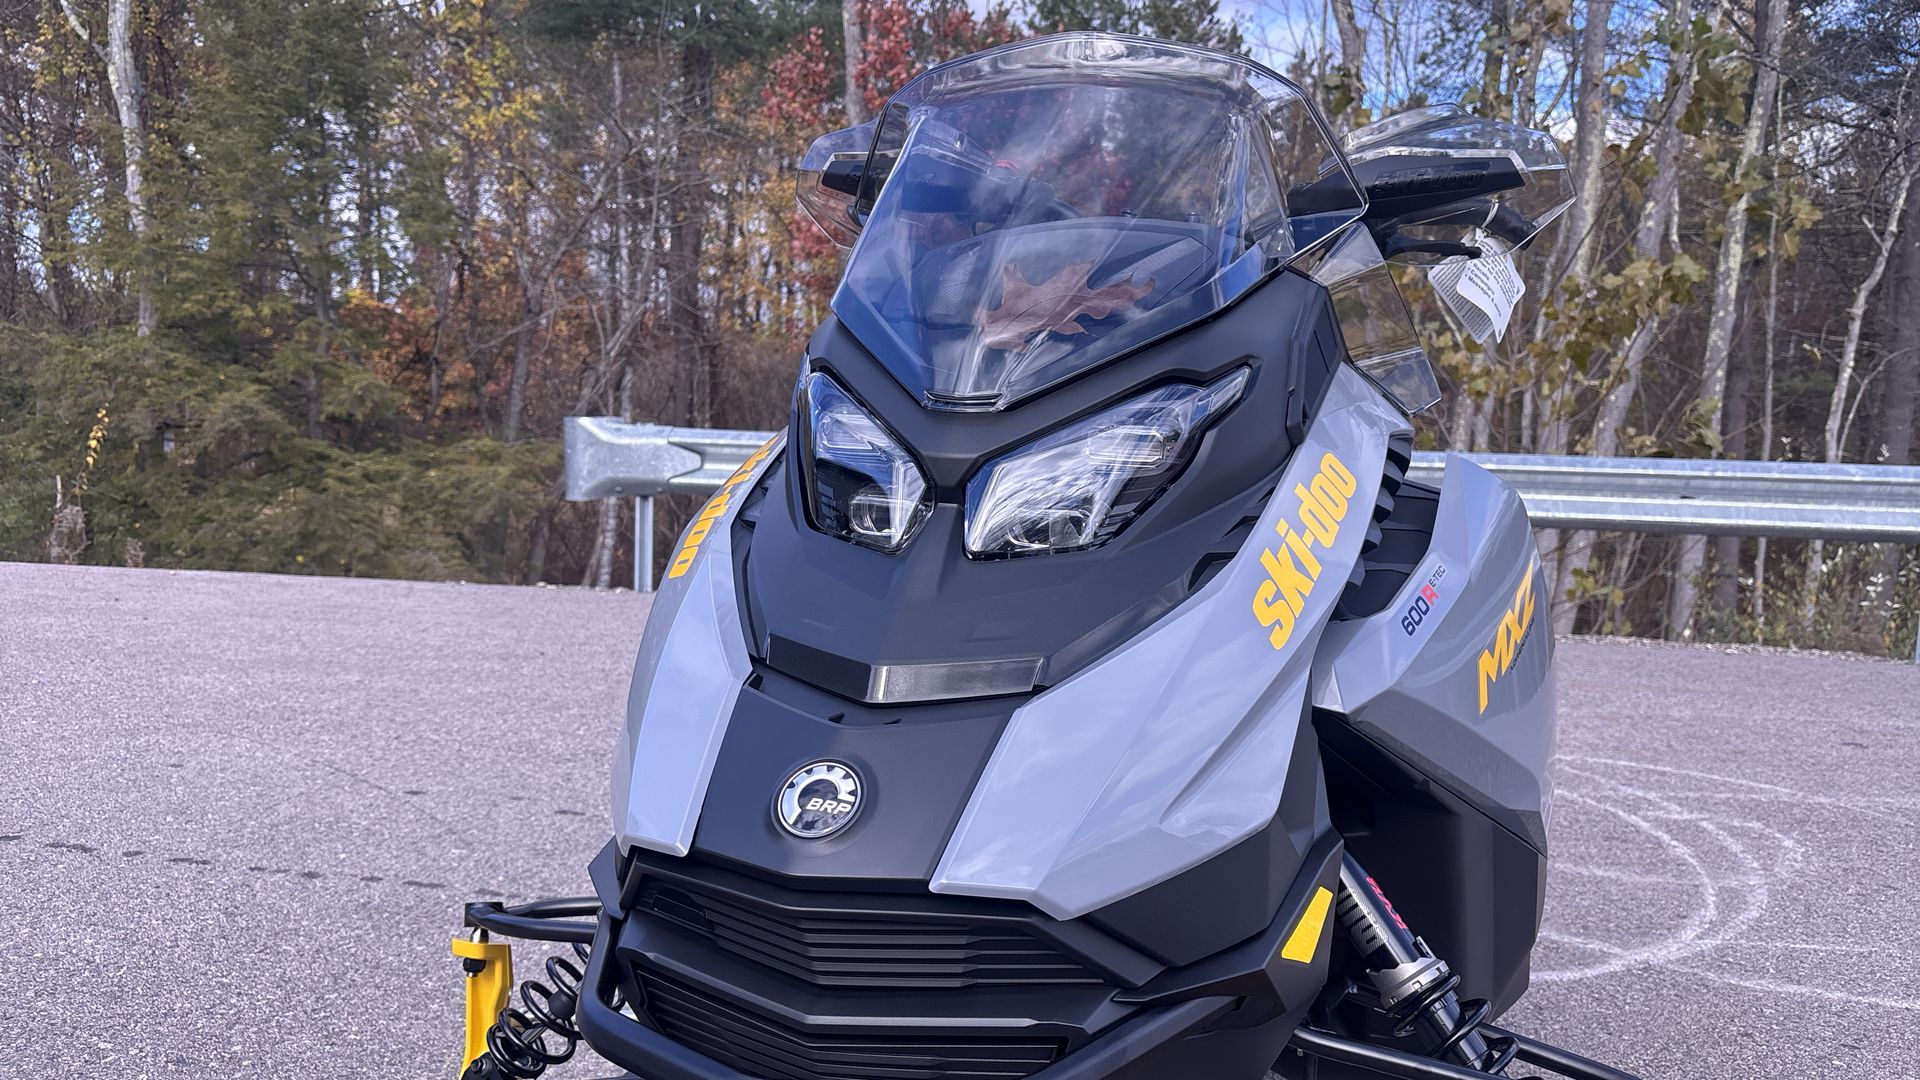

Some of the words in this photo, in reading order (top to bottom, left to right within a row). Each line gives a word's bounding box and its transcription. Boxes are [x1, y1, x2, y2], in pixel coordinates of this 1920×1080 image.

[1252, 452, 1357, 650] ski-doo
[1478, 560, 1536, 716] MXZ
[805, 797, 852, 815] BRP
